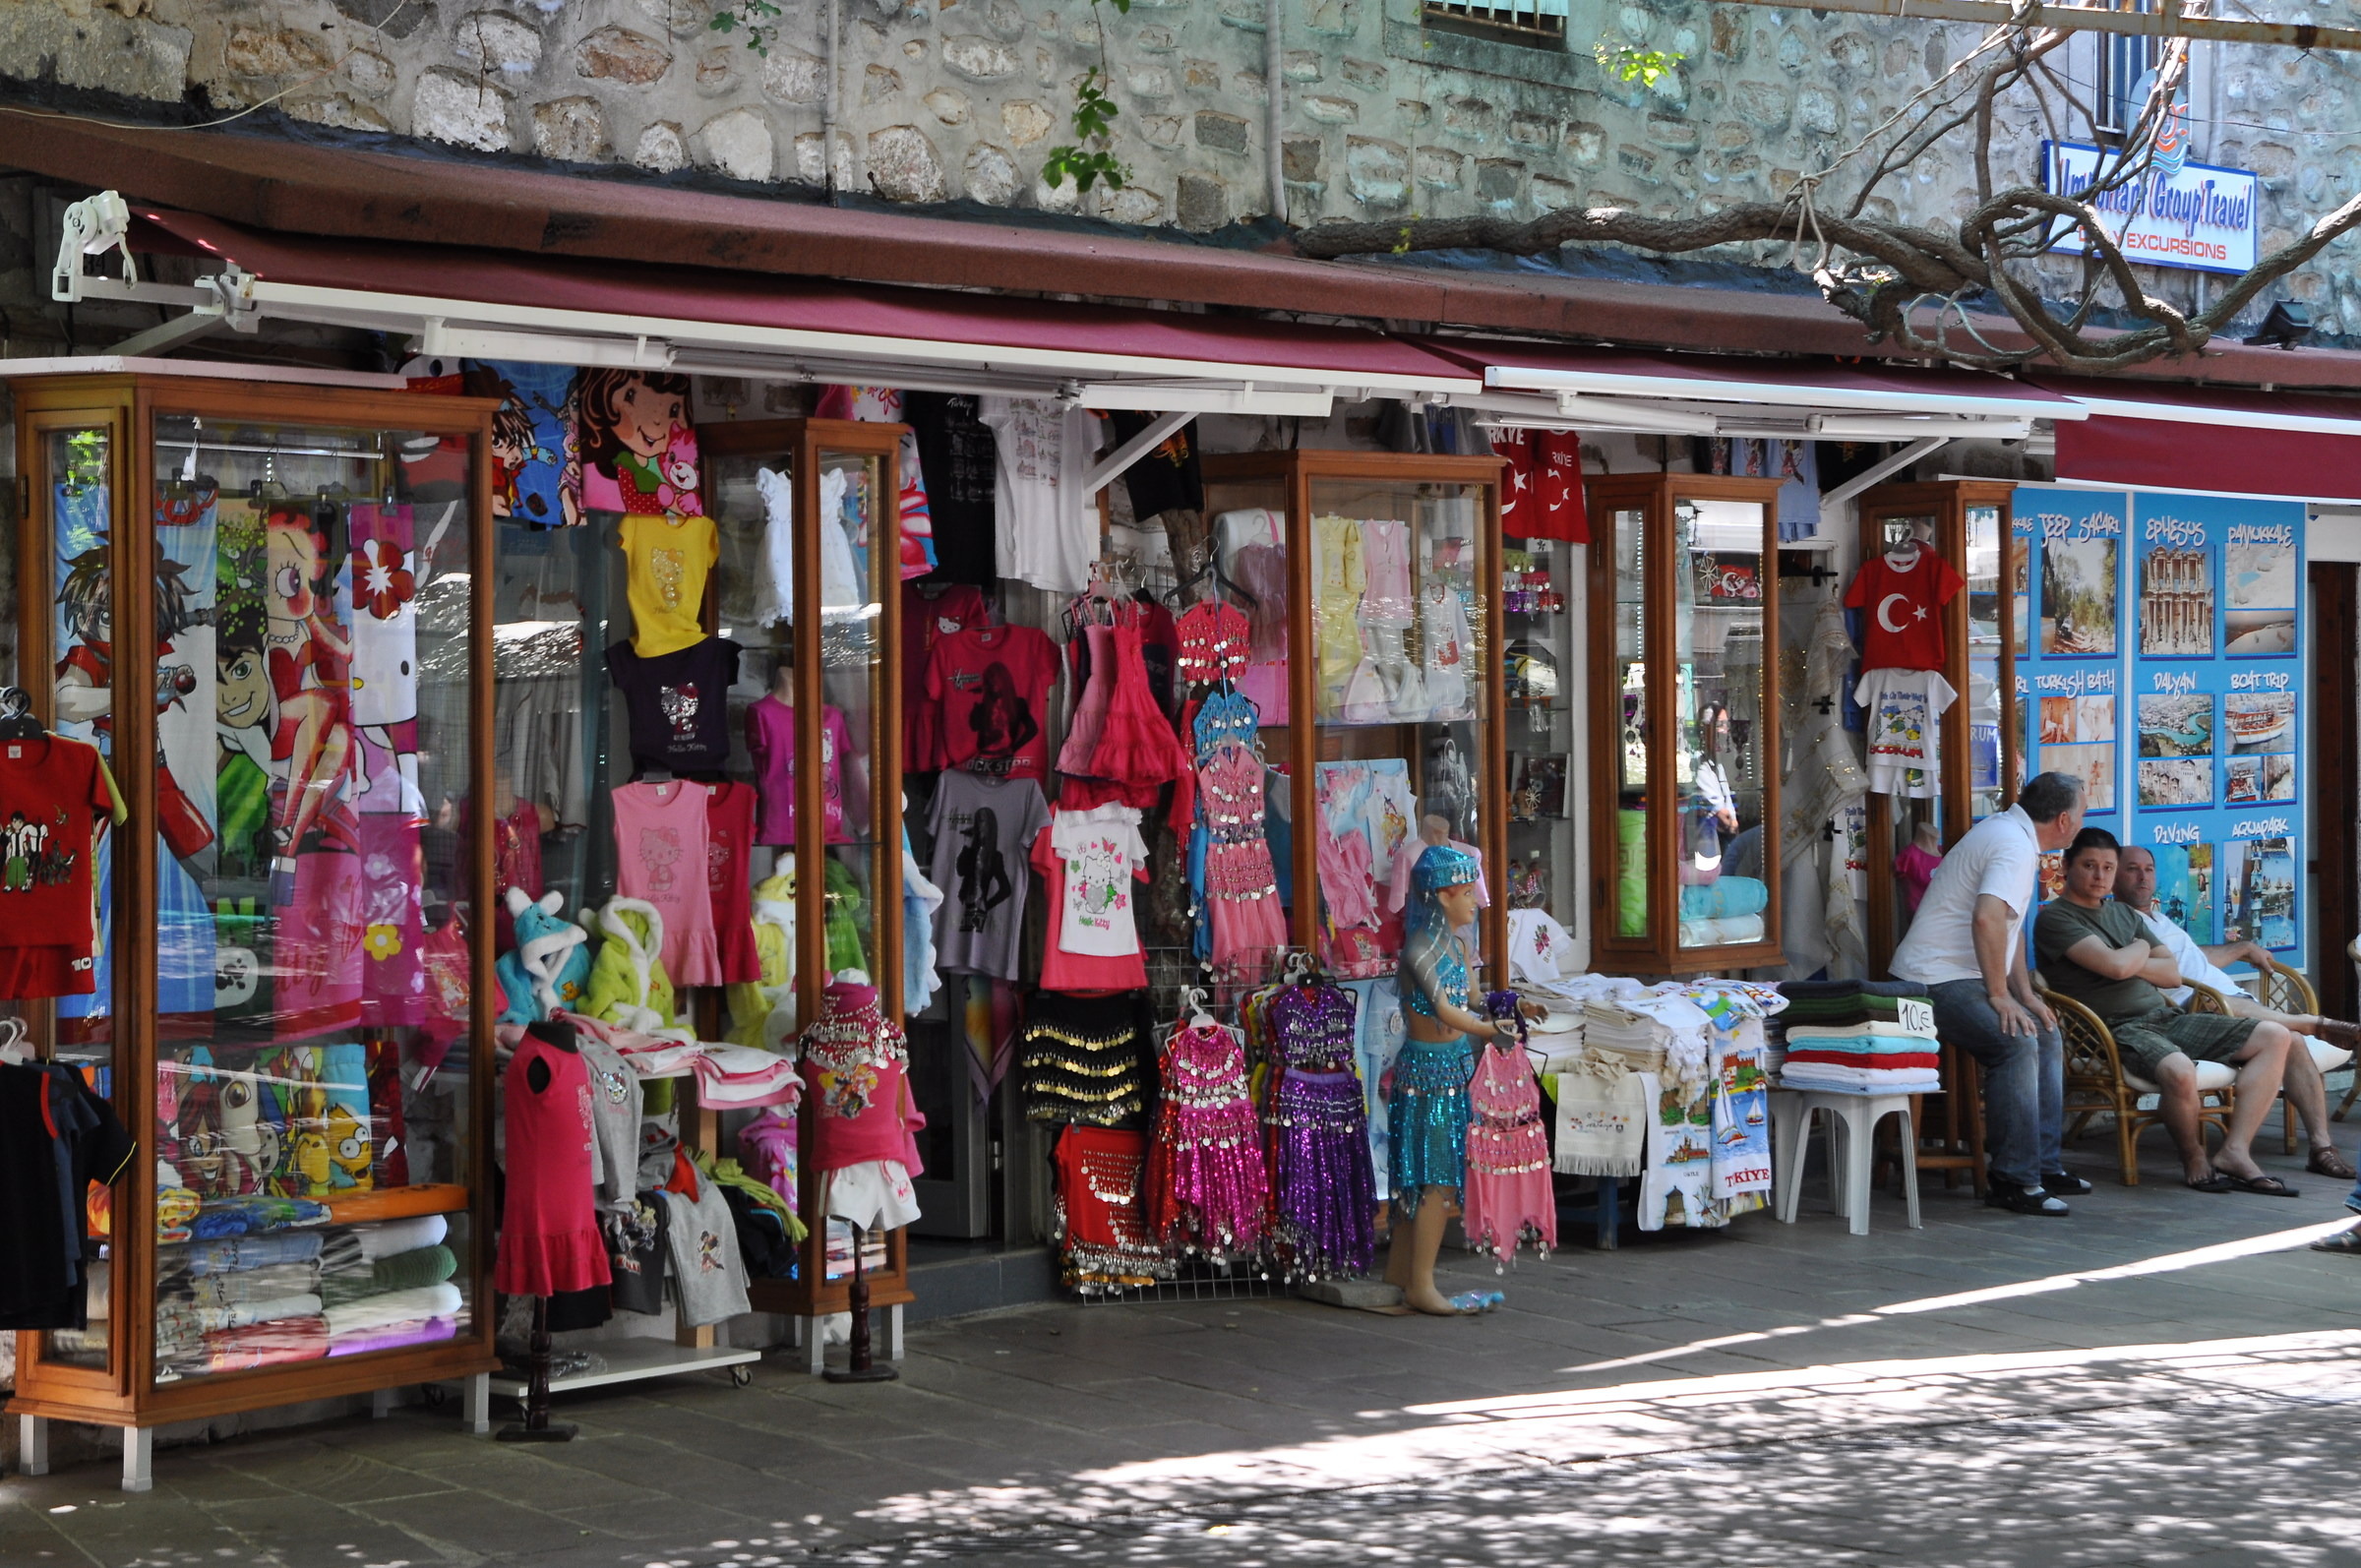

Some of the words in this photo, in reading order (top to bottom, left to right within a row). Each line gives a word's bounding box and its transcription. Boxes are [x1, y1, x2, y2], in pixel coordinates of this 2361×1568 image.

[2149, 171, 2202, 237] Group
[2201, 179, 2253, 230] Travel
[2126, 232, 2227, 261] EXCURSIONS
[2037, 513, 2072, 547] JEEP
[2146, 515, 2206, 547] EPHESUS
[2227, 522, 2293, 550] PAMUKKALE
[2034, 669, 2086, 698] TURKISH
[2087, 669, 2115, 694] BATH
[2153, 671, 2196, 700] DALYAN
[2230, 670, 2262, 693] BOAT
[2263, 672, 2289, 695] TRIP
[2153, 822, 2201, 848] DIVING
[2231, 815, 2289, 840] AQUAPARK
[1094, 916, 1111, 931] Kitty
